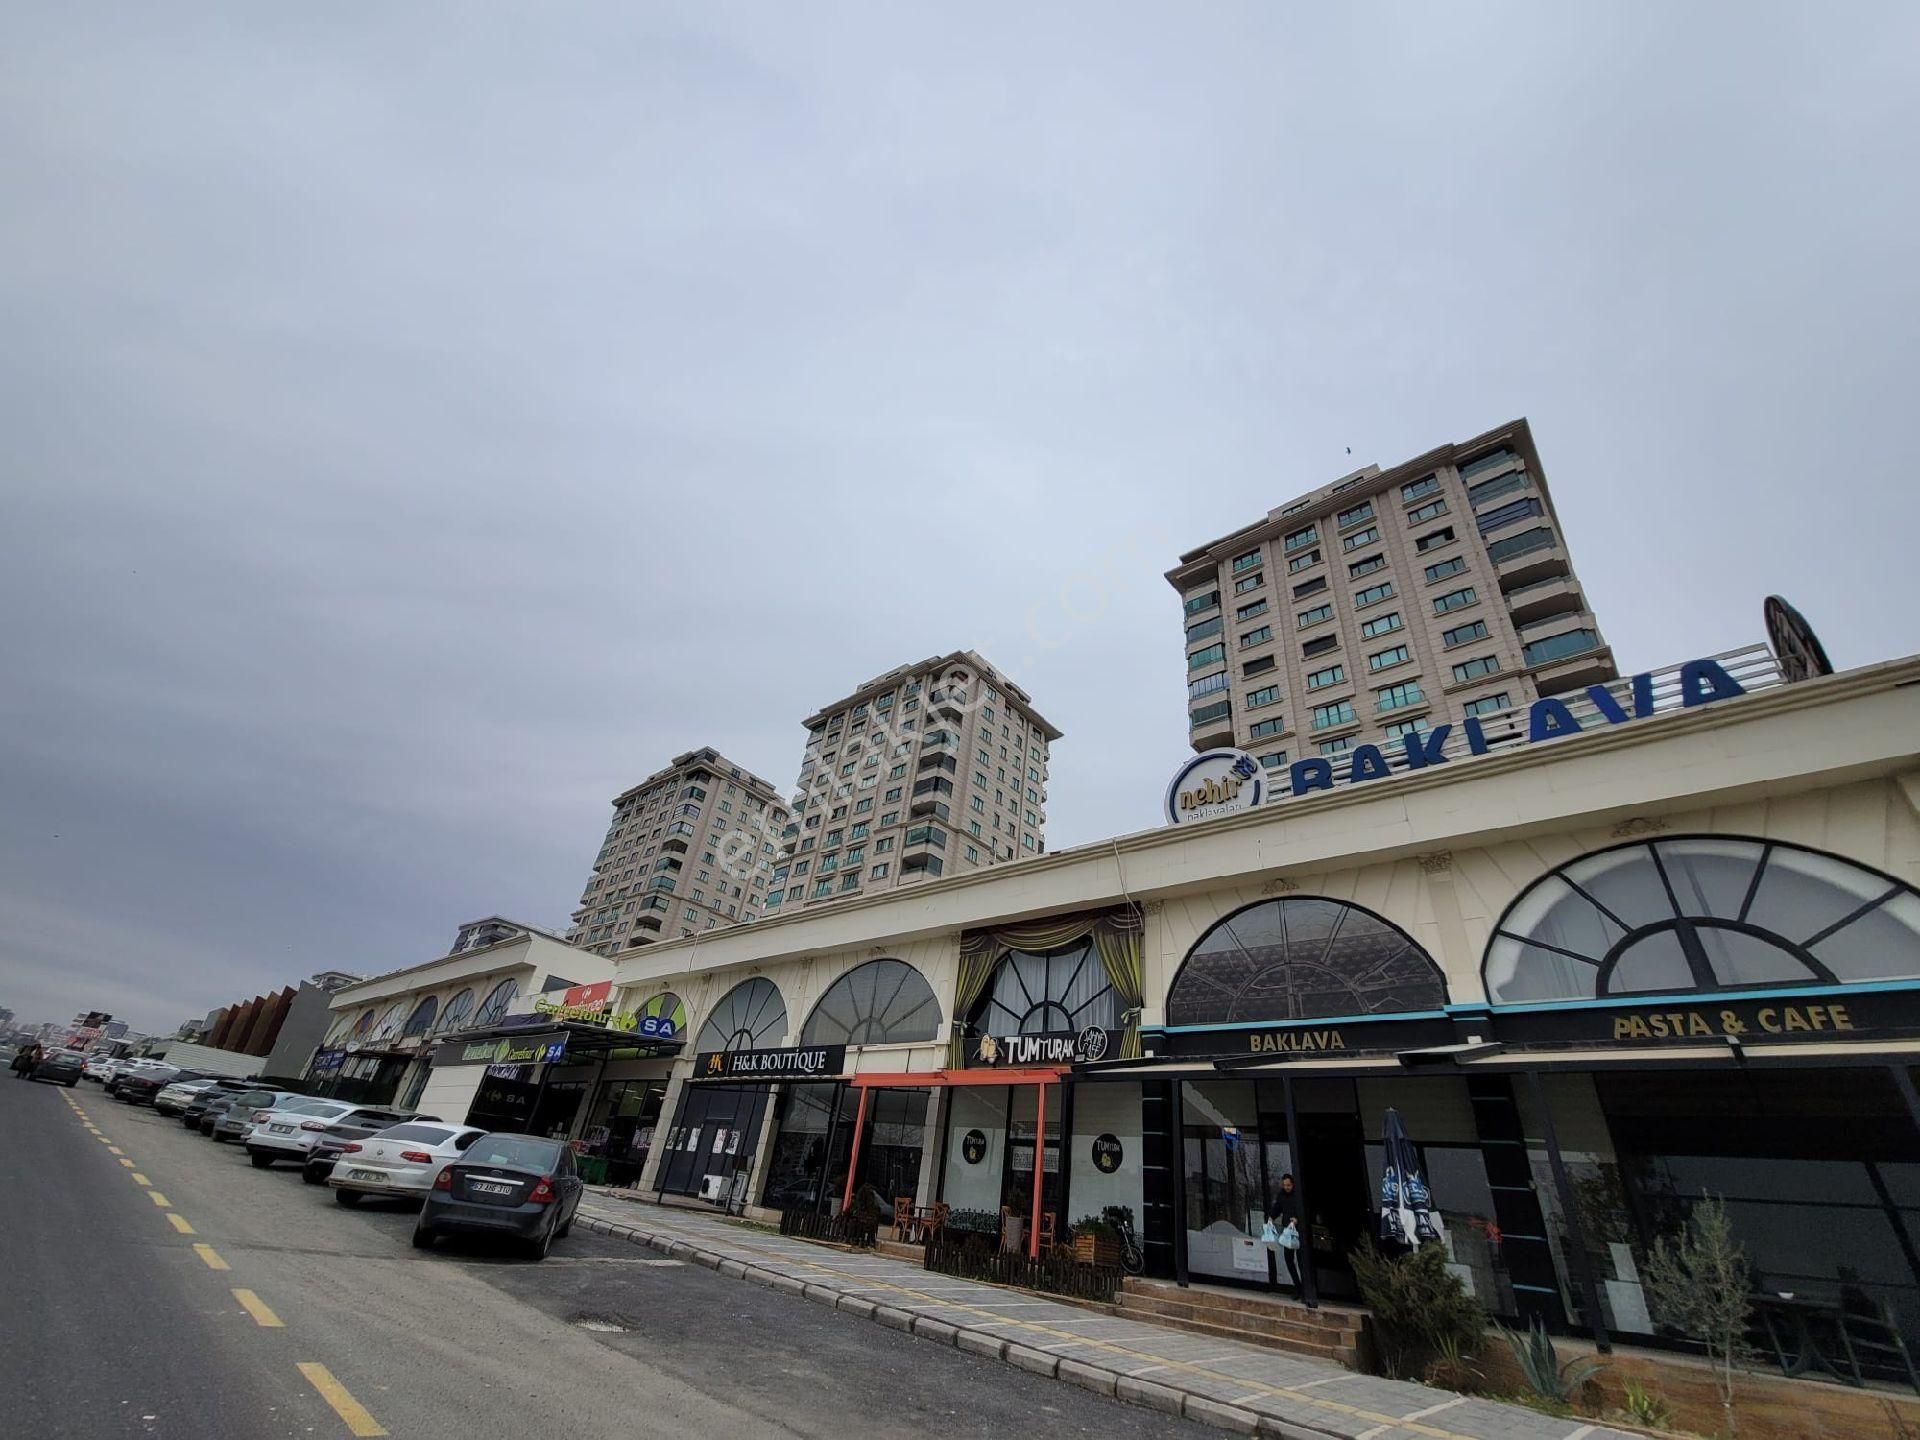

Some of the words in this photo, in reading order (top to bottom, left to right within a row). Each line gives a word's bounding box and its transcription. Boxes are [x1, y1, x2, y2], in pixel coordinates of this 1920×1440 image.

[1180, 776, 1242, 809] nehir
[644, 1019, 673, 1036] SA
[1613, 1013, 1713, 1039] PASTA
[1720, 1010, 1748, 1035] &
[1757, 1005, 1854, 1033] CAFE
[546, 1045, 562, 1057] SA
[1005, 1037, 1075, 1064] TUMTURAK
[1250, 1031, 1346, 1052] BAKLAVA
[732, 1054, 758, 1071] H&K
